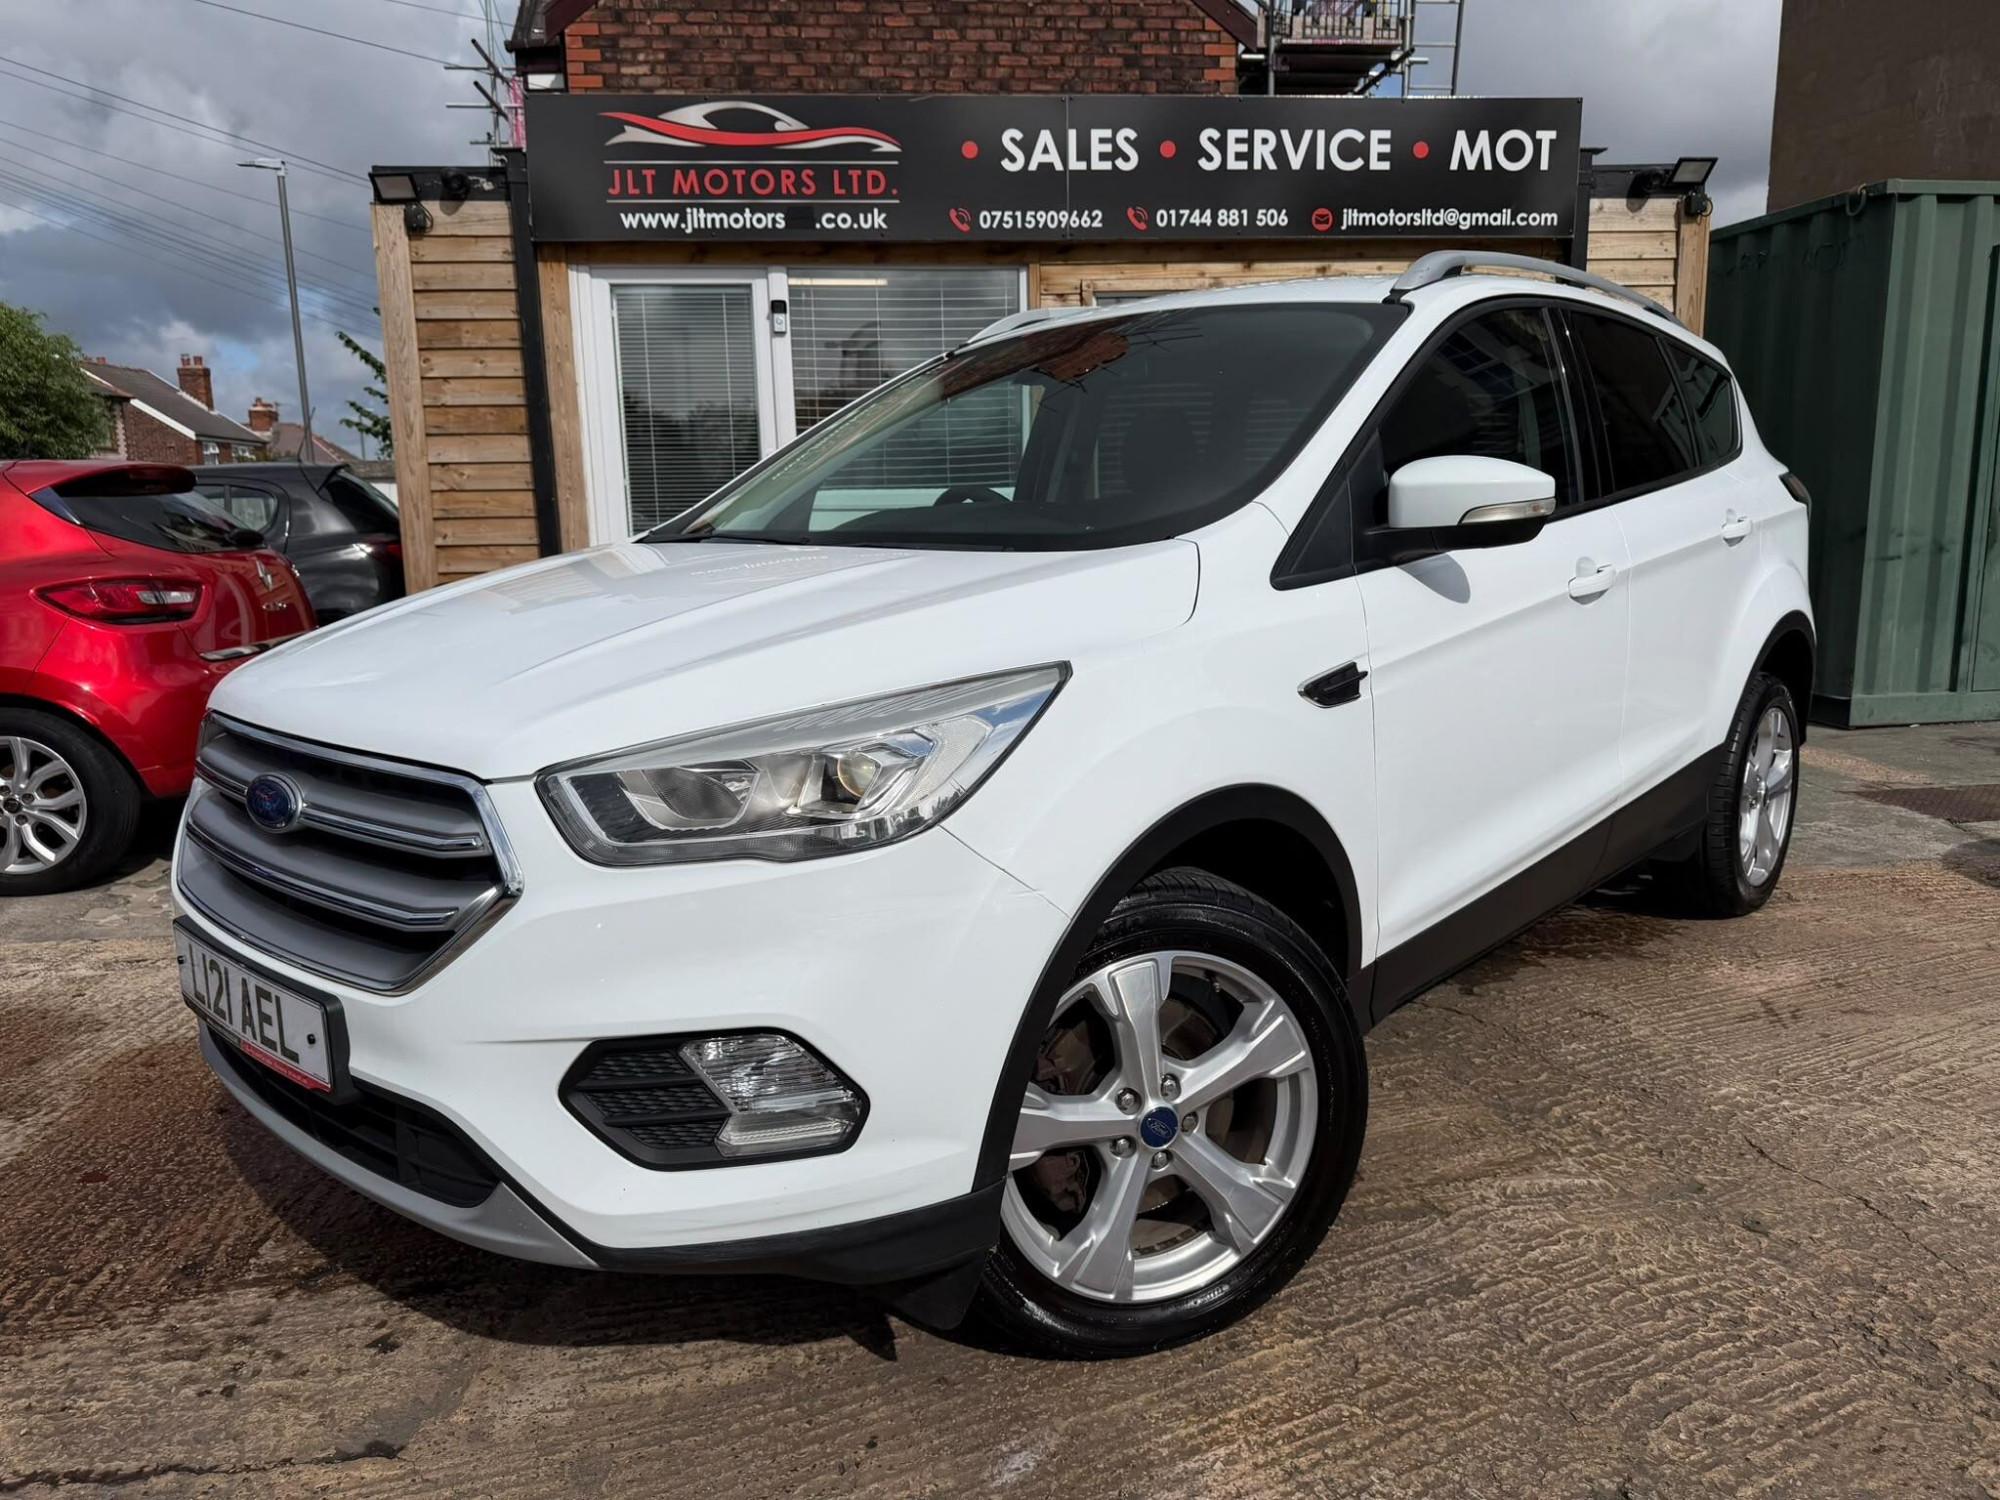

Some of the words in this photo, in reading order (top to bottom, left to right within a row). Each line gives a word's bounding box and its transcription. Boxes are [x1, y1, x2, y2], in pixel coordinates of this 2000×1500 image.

[1001, 128, 1138, 171] SALES
[1198, 128, 1391, 171] SERVICE
[1450, 130, 1556, 171] MOT
[608, 170, 655, 195] JLT
[673, 169, 816, 195] MOTORS
[834, 170, 897, 195] LTD.
[620, 208, 785, 233] www.jltmotors
[980, 210, 1102, 228] 07515909662
[1157, 209, 1212, 227] 01744
[1217, 209, 1247, 226] 881
[1256, 209, 1288, 226] 506
[1341, 209, 1557, 229] jltmotorsltd@gmail.com
[241, 976, 300, 1064] AEL
